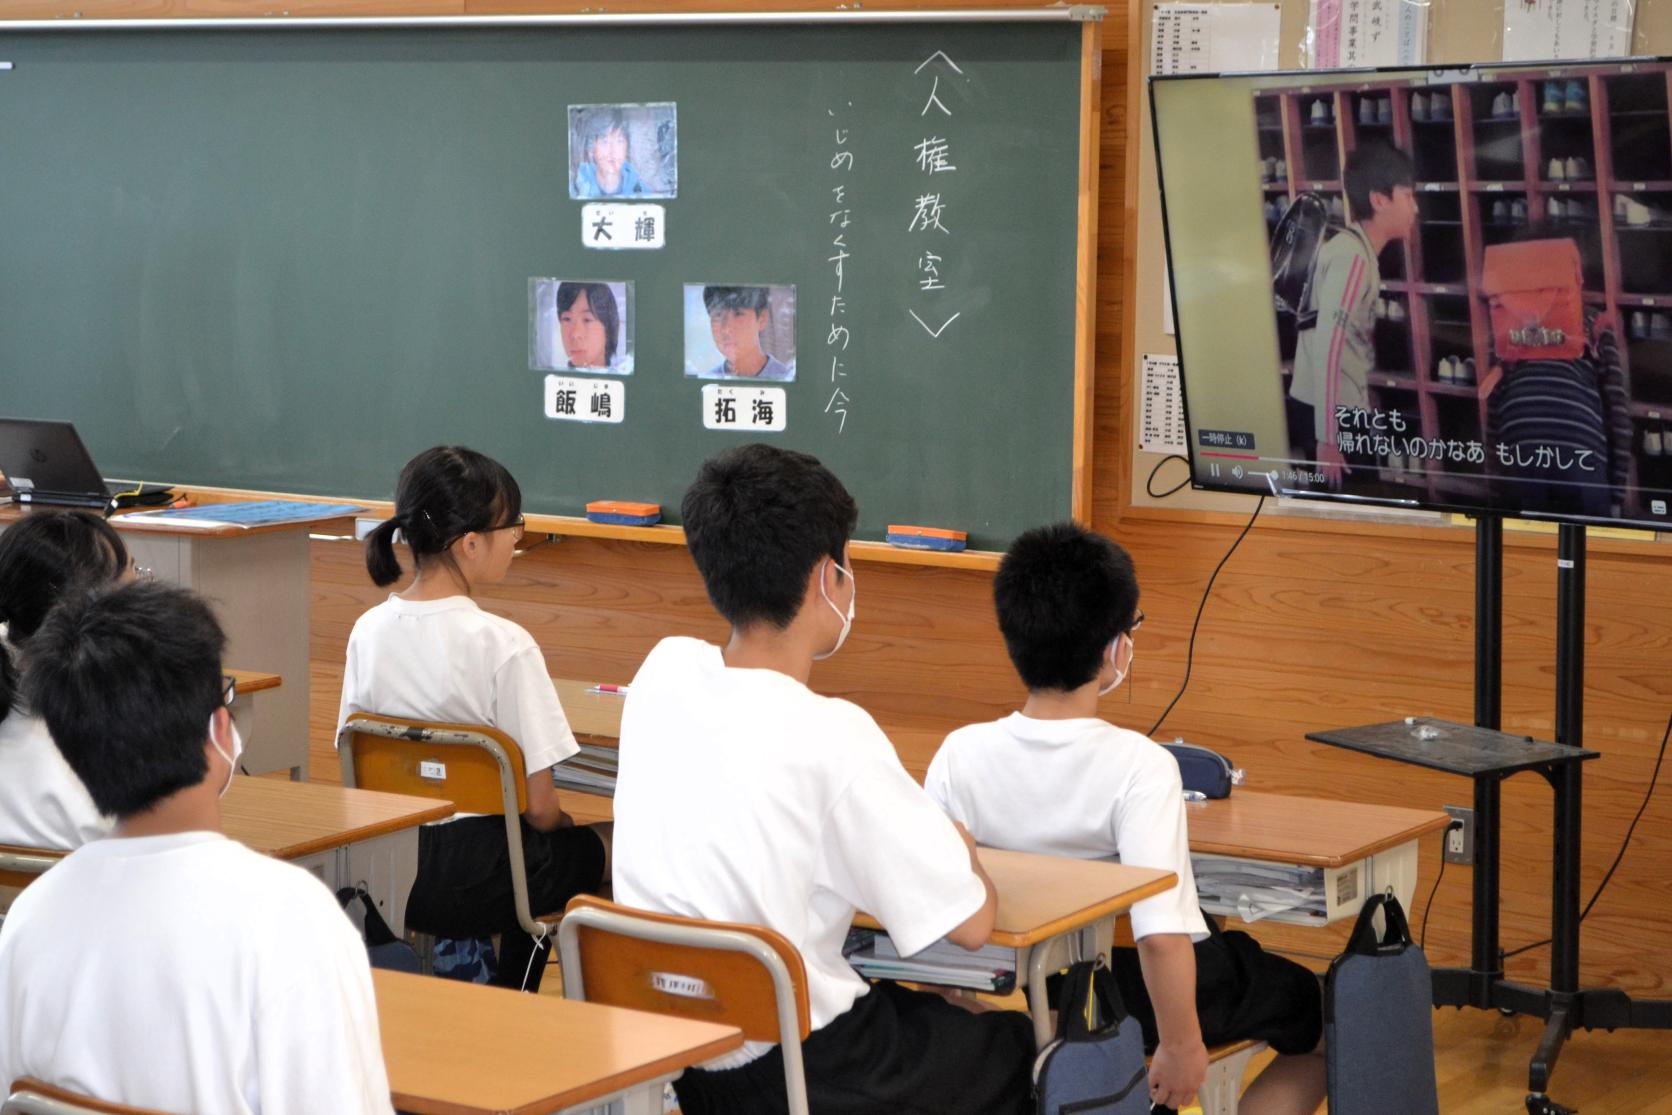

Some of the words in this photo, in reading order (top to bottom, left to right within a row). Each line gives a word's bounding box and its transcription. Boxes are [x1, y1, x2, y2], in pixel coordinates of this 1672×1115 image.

[825, 102, 853, 434] いじめをなくすために今
[714, 398, 774, 425] 拓海
[1335, 405, 1407, 432] それとも
[1336, 432, 1485, 464] 帰れないのかなあ
[1496, 442, 1596, 472] もしかして
[1303, 472, 1325, 484] 15:00
